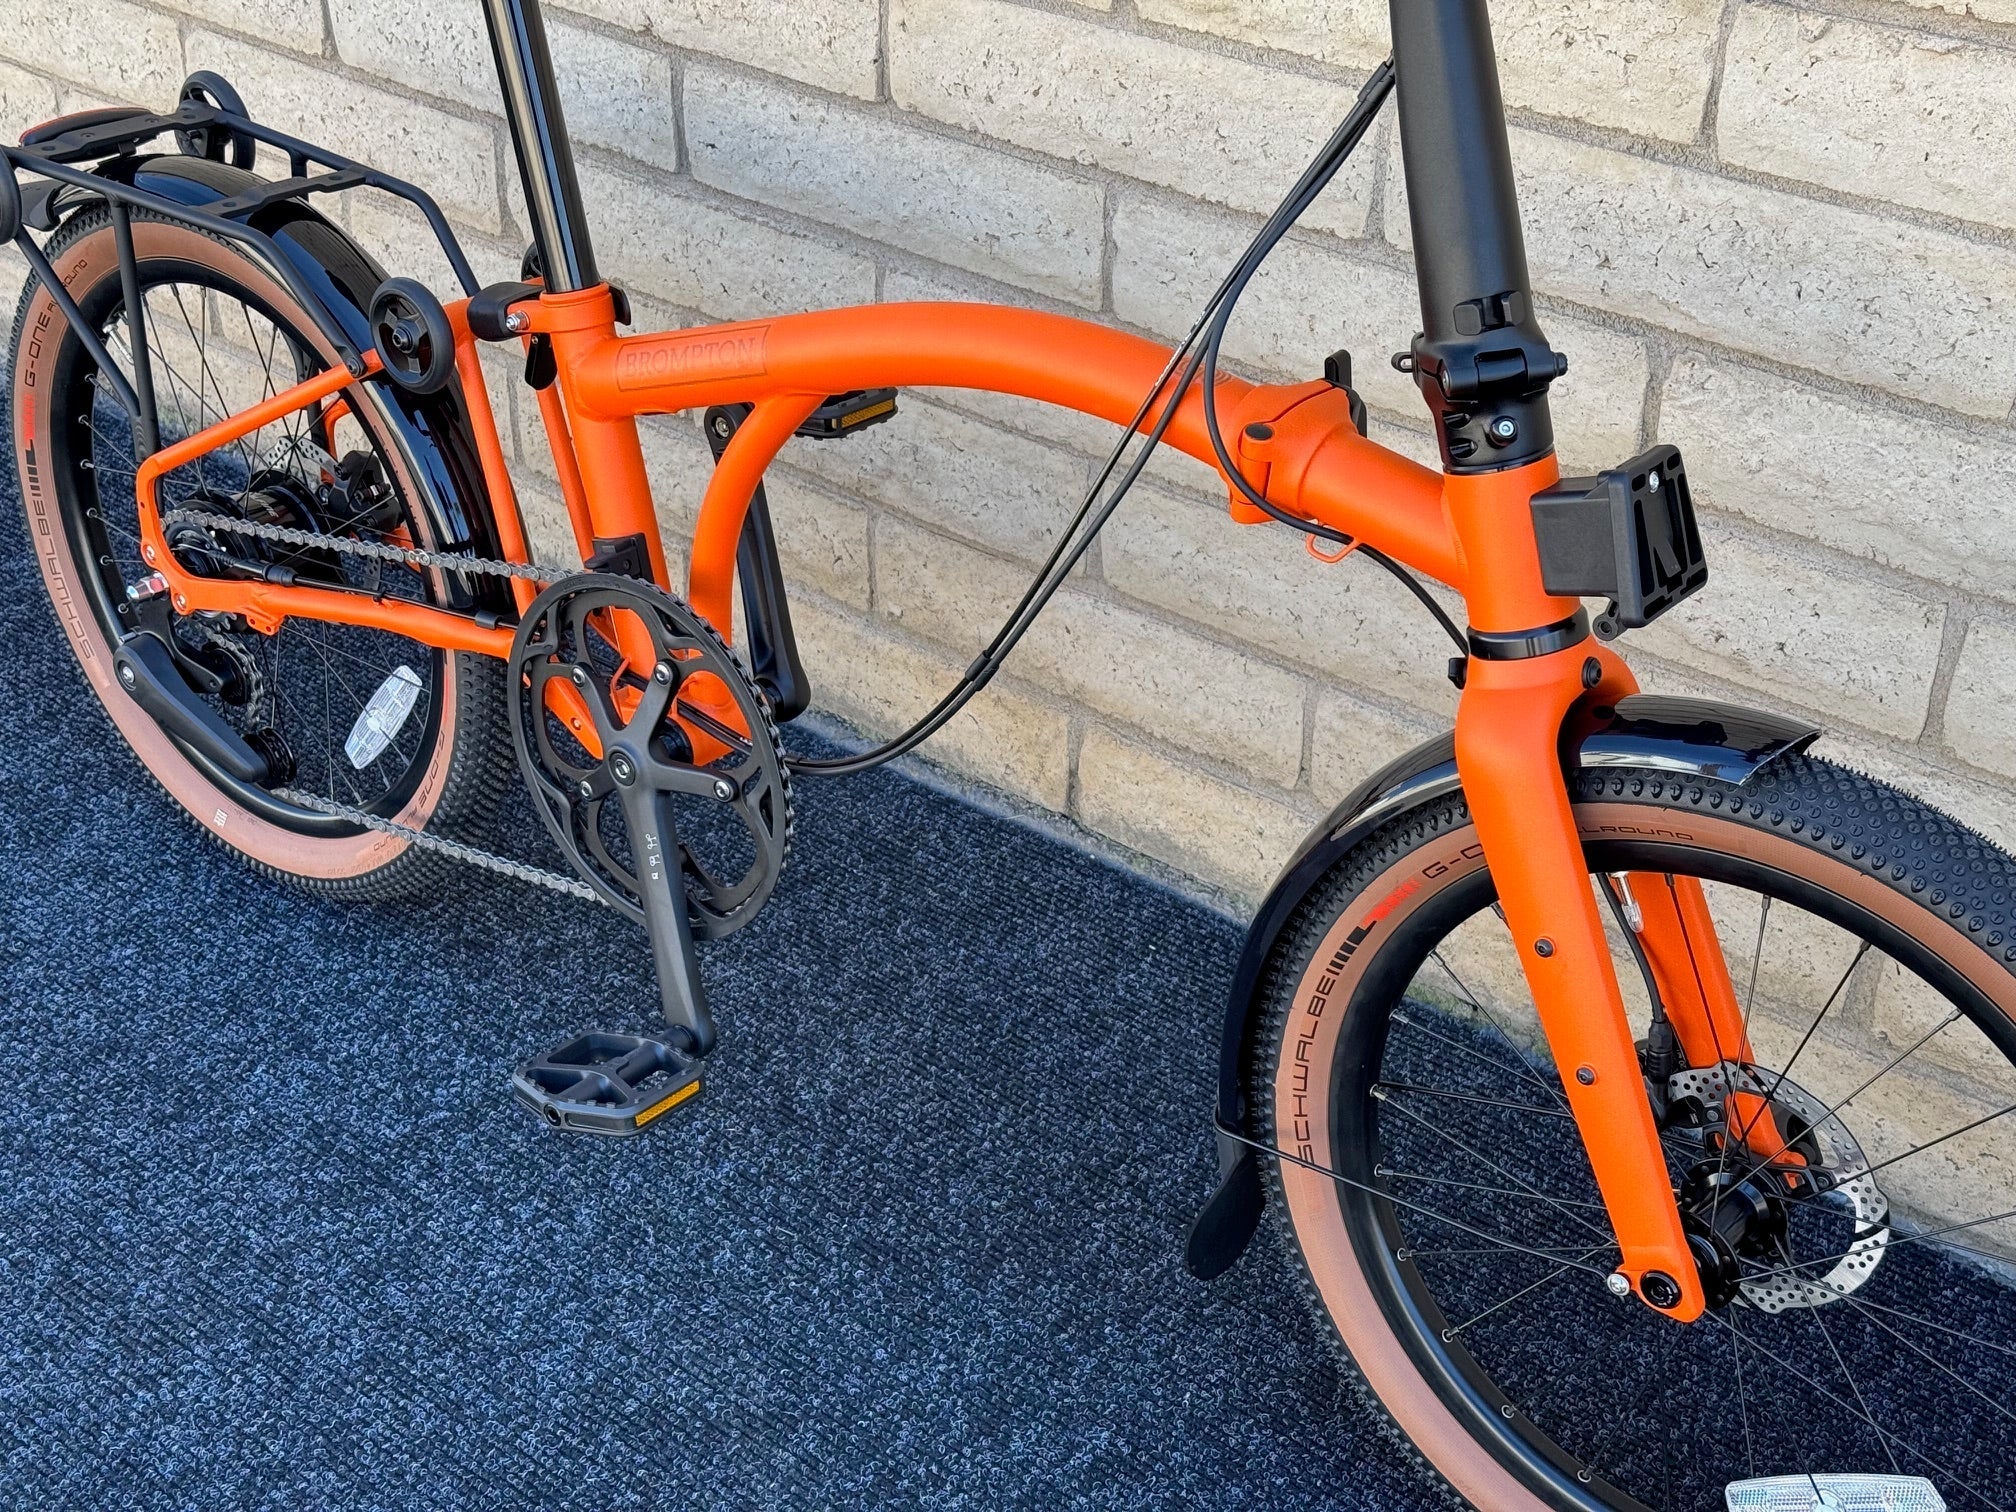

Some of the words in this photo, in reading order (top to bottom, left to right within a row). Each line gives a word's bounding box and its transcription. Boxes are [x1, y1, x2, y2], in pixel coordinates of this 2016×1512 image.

[24, 311, 51, 388] G-ONE
[47, 259, 88, 313] AOUND
[625, 336, 756, 378] BROMPTON
[32, 499, 95, 660] SCHWALBE
[418, 730, 446, 808] G-ONE
[1421, 842, 1485, 879] G-O
[1576, 825, 1694, 841] LROUND
[1292, 974, 1337, 1169] SCHWALBE
